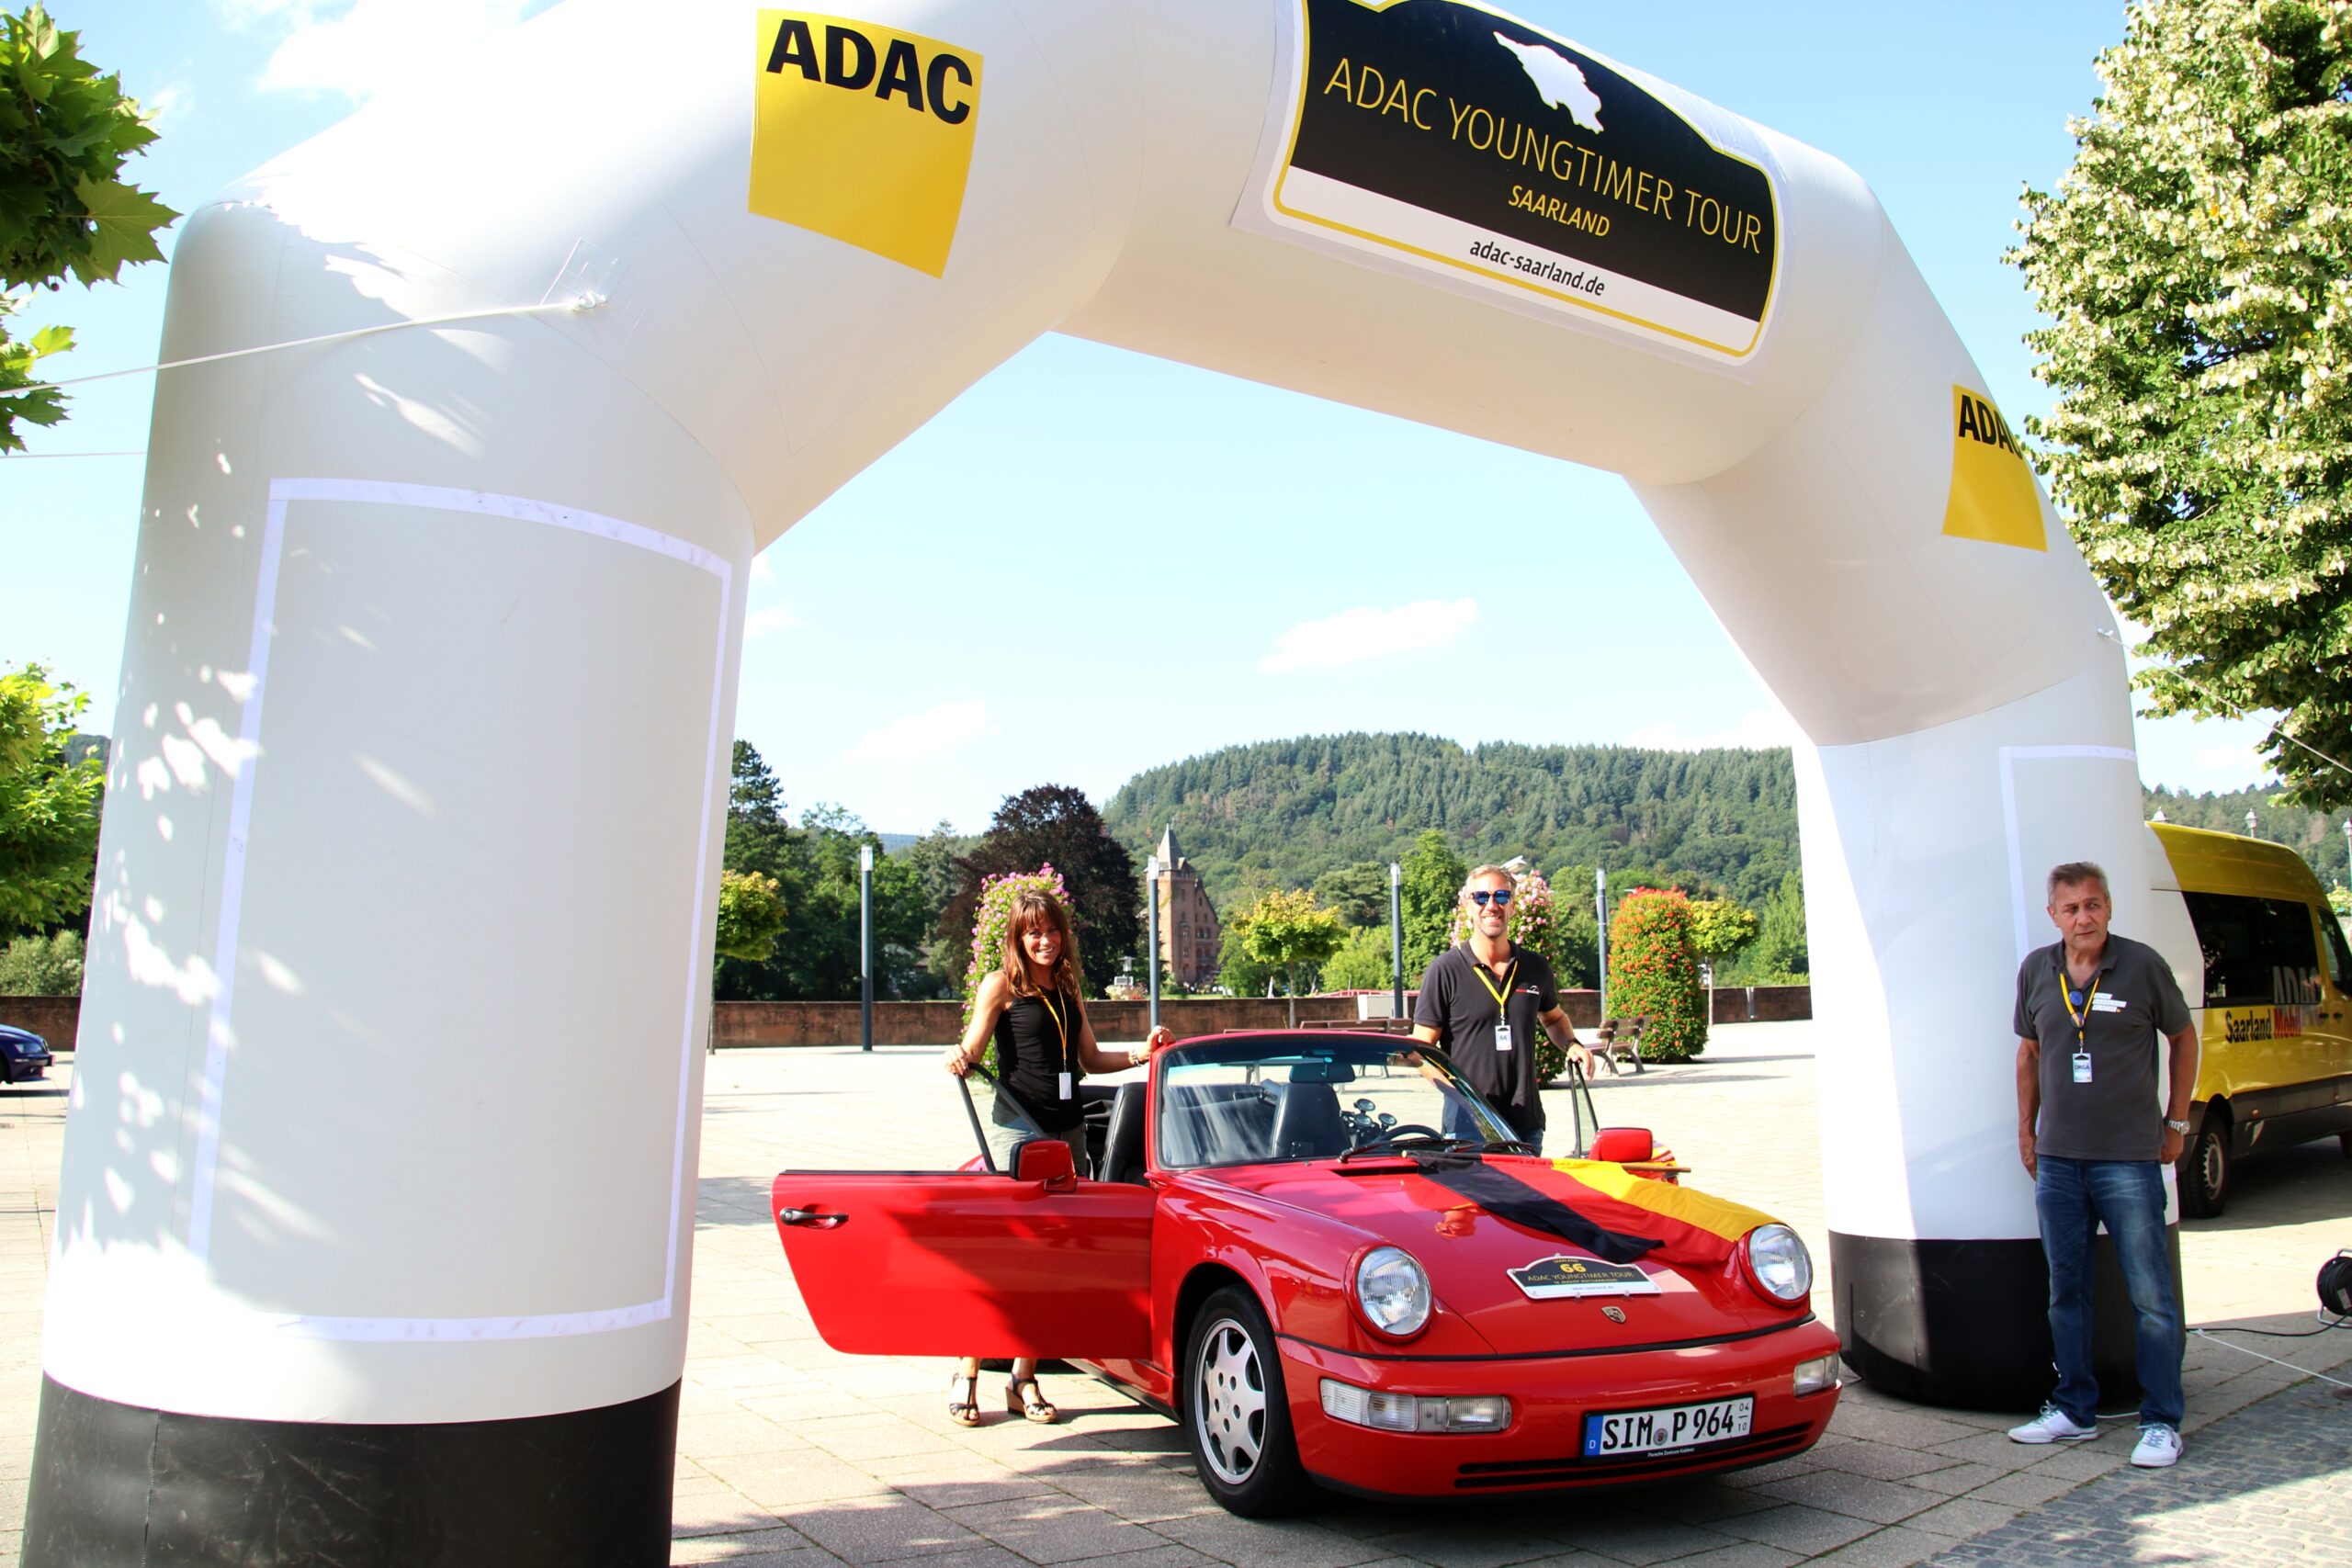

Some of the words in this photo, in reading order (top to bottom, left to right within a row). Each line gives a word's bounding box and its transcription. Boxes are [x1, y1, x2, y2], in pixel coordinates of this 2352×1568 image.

[765, 18, 973, 125] ADAC
[1324, 58, 1437, 130] ADAC
[1449, 97, 1673, 220] YOUNGTIMER
[1685, 189, 1761, 254] TOUR
[1509, 185, 1610, 237] SAARLAND
[1469, 239, 1605, 297] adac-saarland.de
[1560, 1263, 1586, 1273] 66
[1589, 1440, 1596, 1449] D
[1602, 1416, 1654, 1450] SIM
[1693, 1404, 1734, 1438] 964
[1737, 1422, 1747, 1432] 10
[1738, 1402, 1750, 1412] 04
